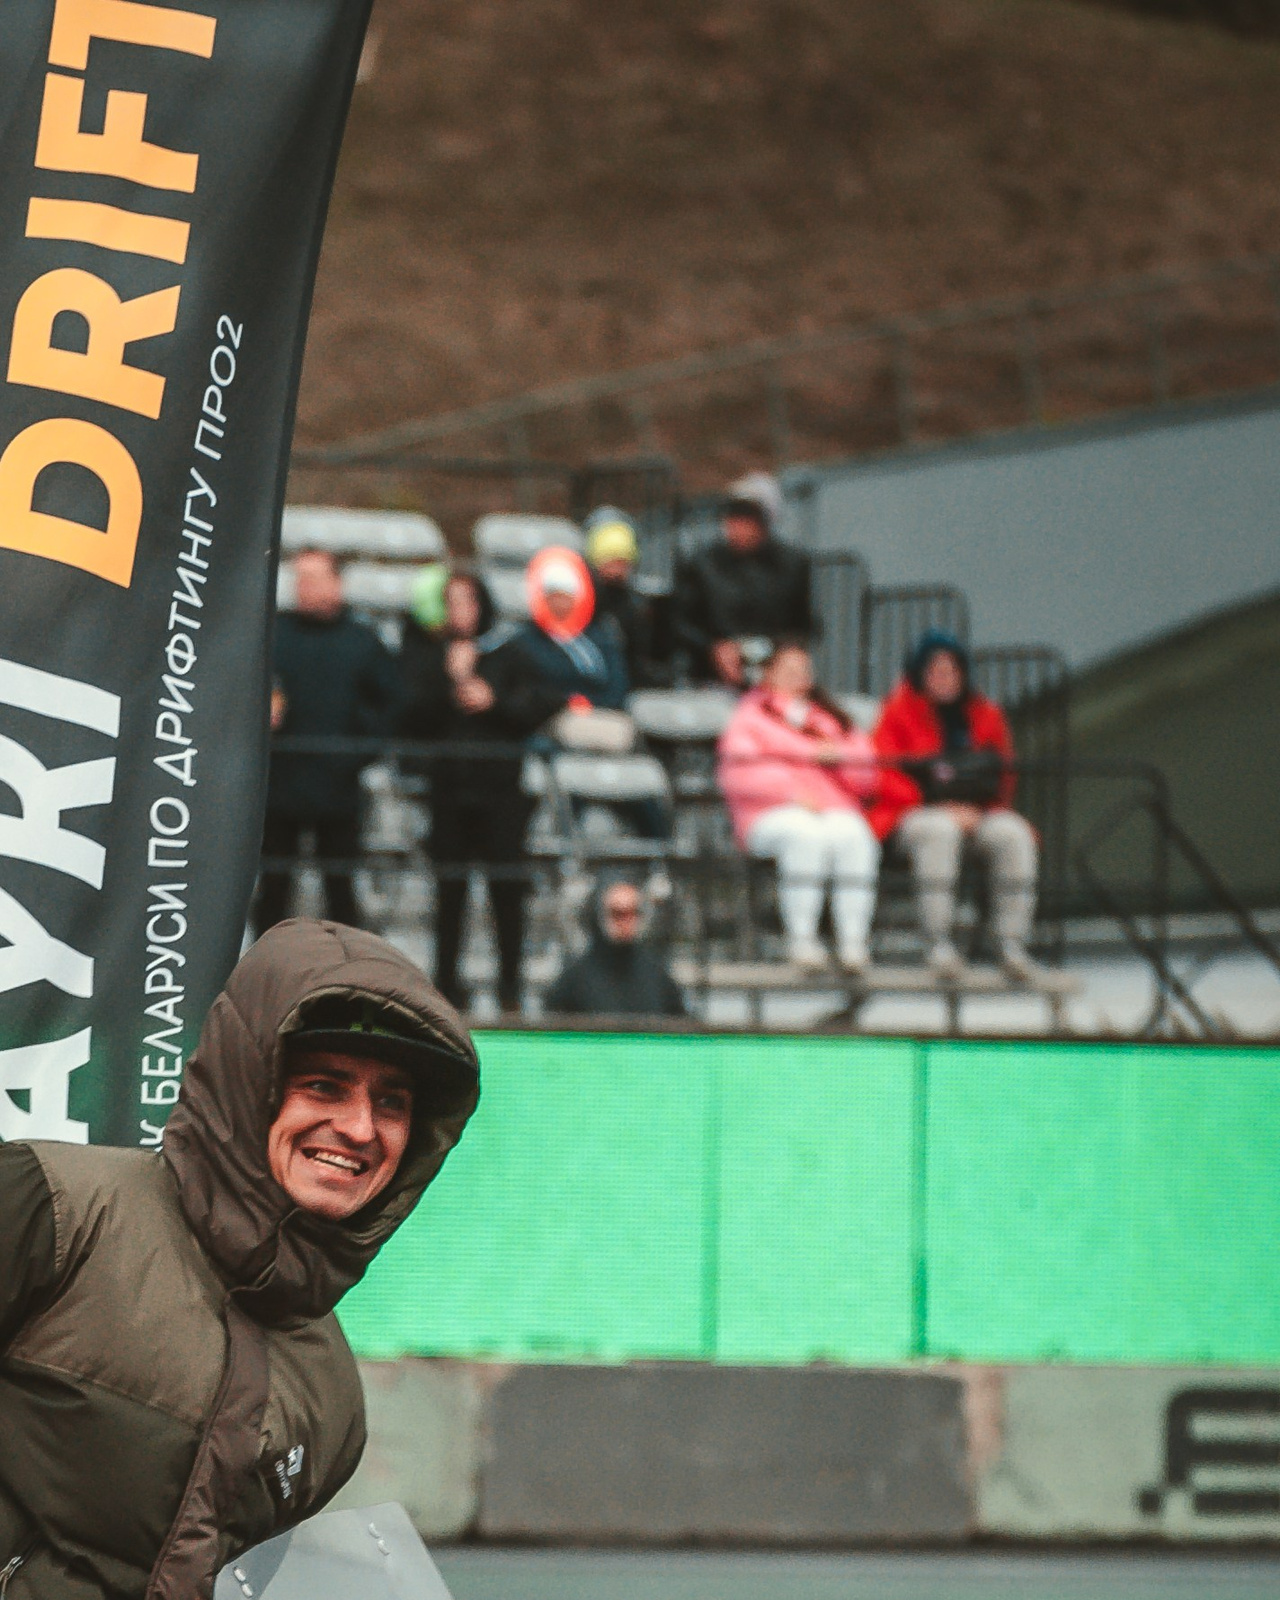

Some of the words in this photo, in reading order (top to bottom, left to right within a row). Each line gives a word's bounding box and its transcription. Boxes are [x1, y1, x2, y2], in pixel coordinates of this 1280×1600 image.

[194, 314, 245, 462] ПРО2
[153, 466, 219, 788] ДРИФТИНГУ
[147, 795, 191, 869] ПО
[141, 882, 189, 1105] БЕЛАРУСИ
